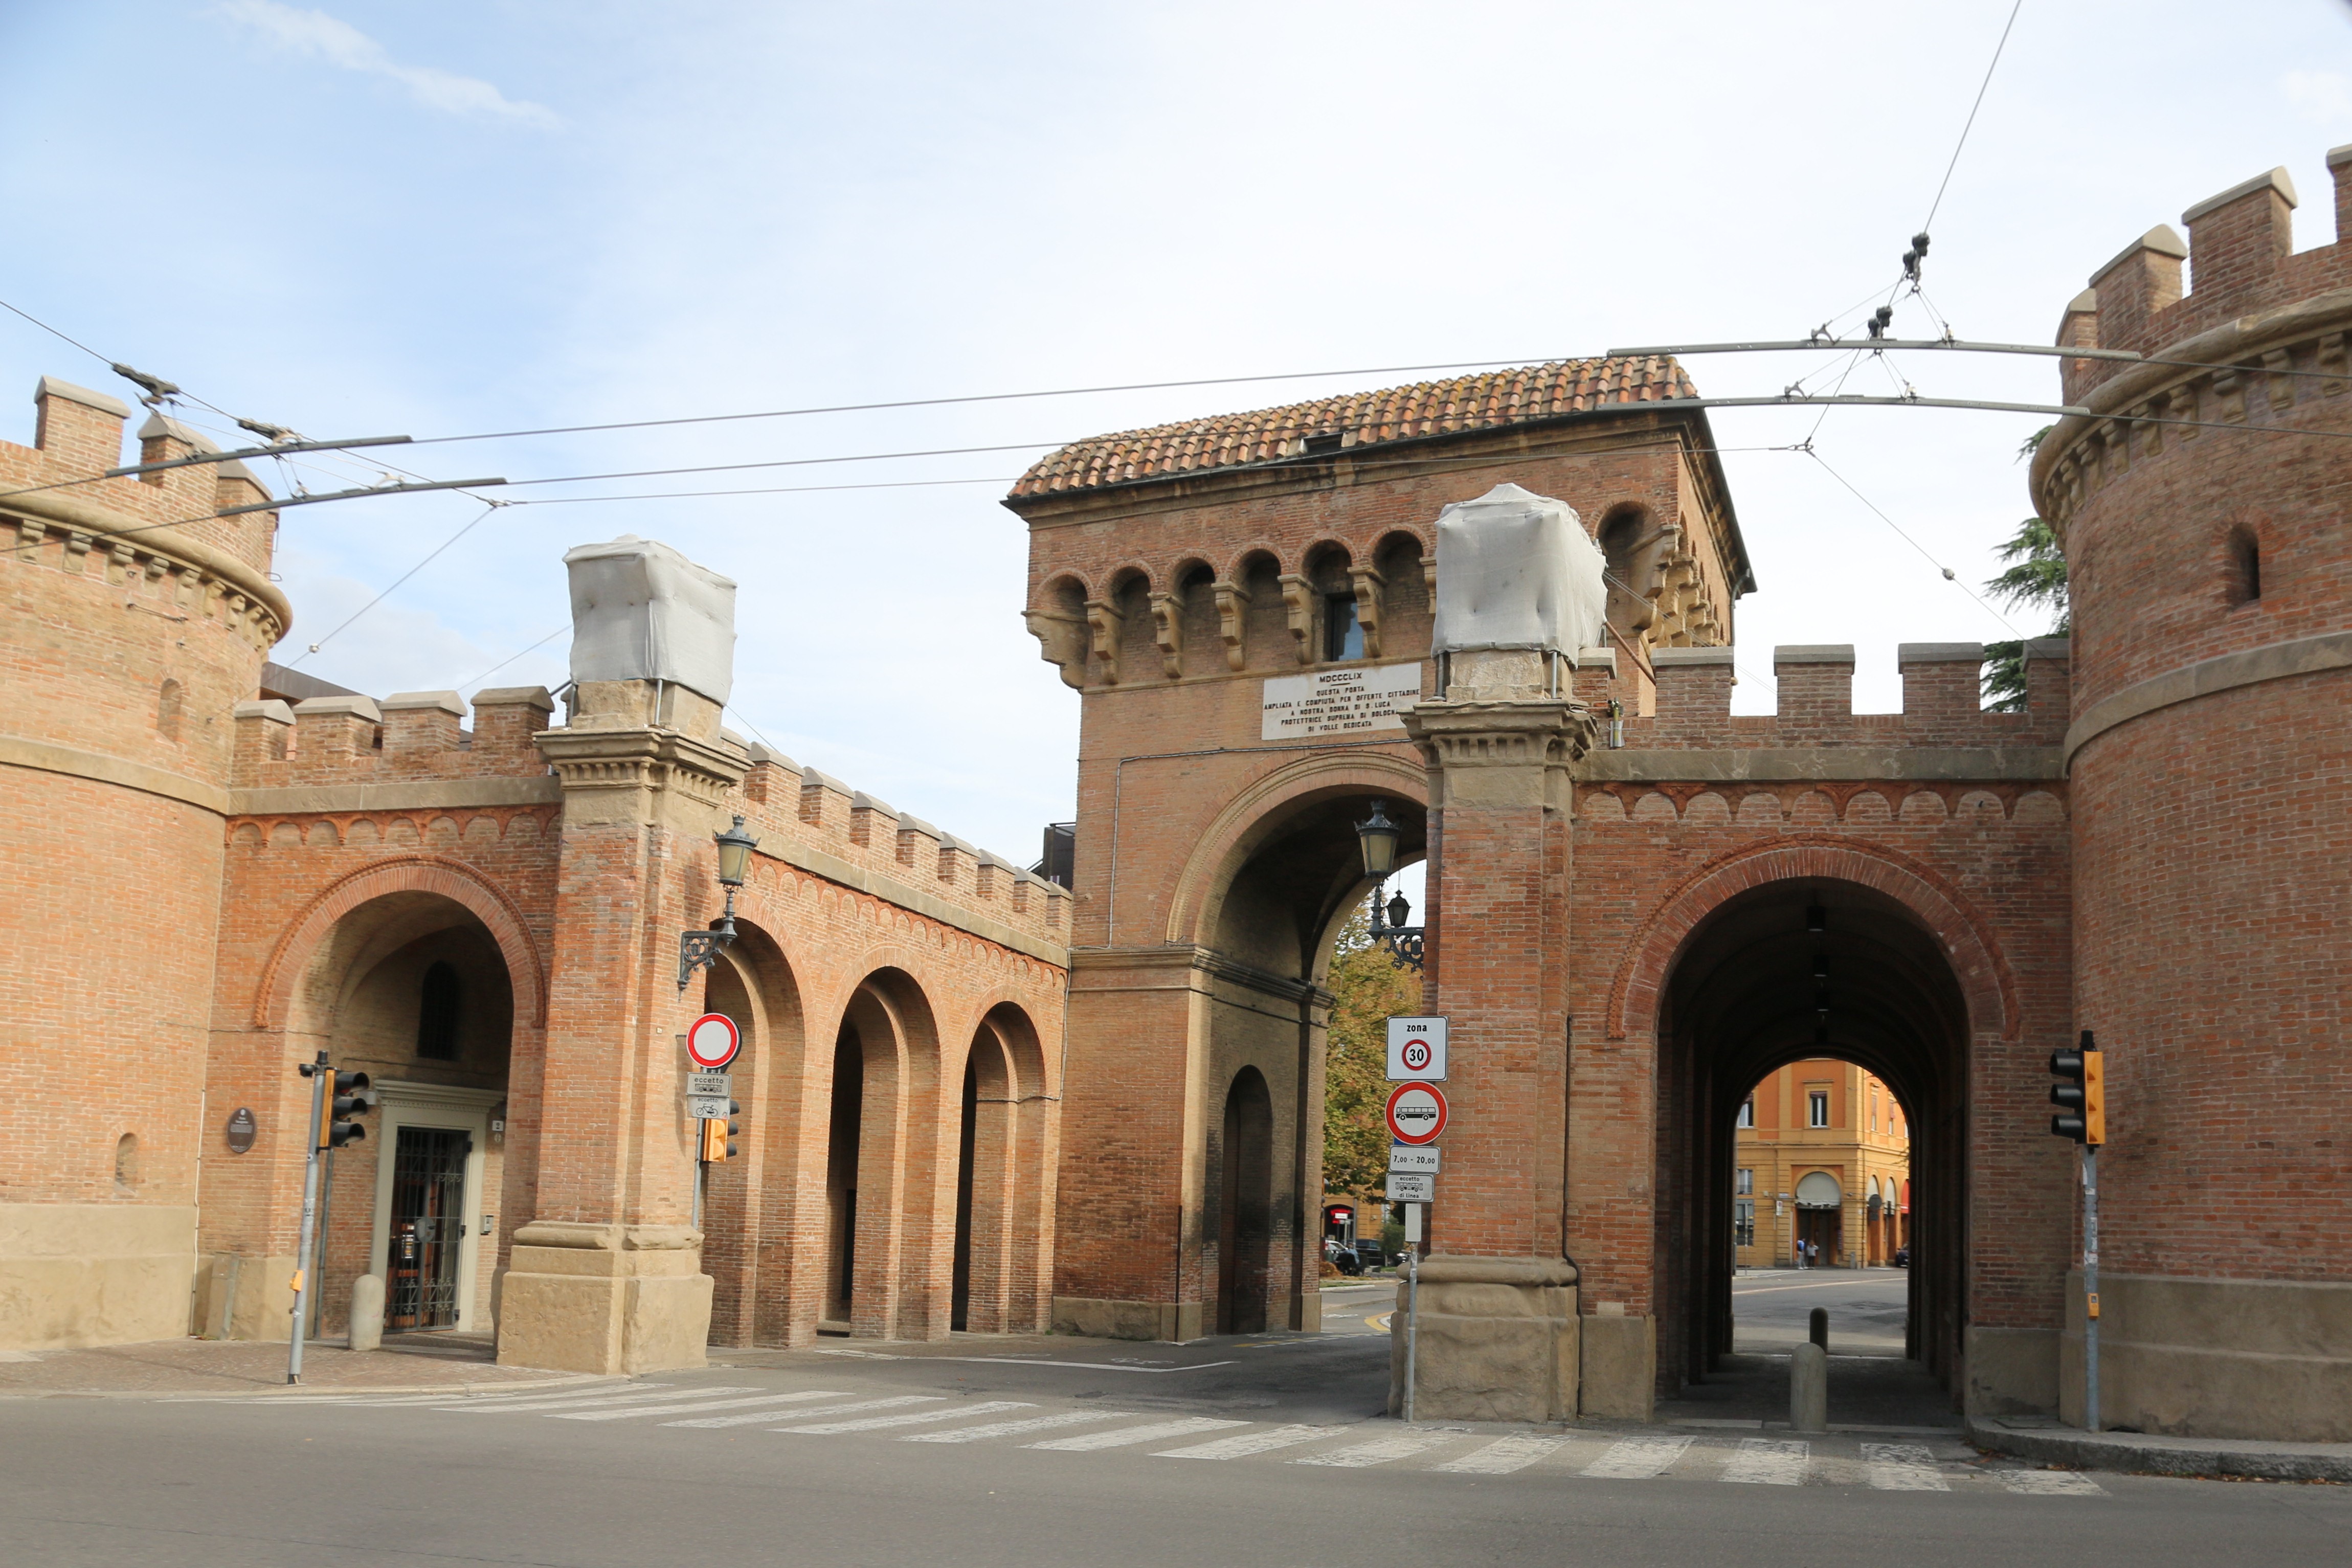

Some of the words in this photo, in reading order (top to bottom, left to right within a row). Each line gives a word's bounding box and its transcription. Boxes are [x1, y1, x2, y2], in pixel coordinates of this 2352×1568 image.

[1319, 672, 1362, 682] MDCCCLIX
[1264, 702, 1291, 710] AMPLIATA
[1388, 689, 1420, 698] CITTADINE
[1281, 716, 1322, 725] PROTETTRICE
[1409, 1049, 1424, 1061] 30
